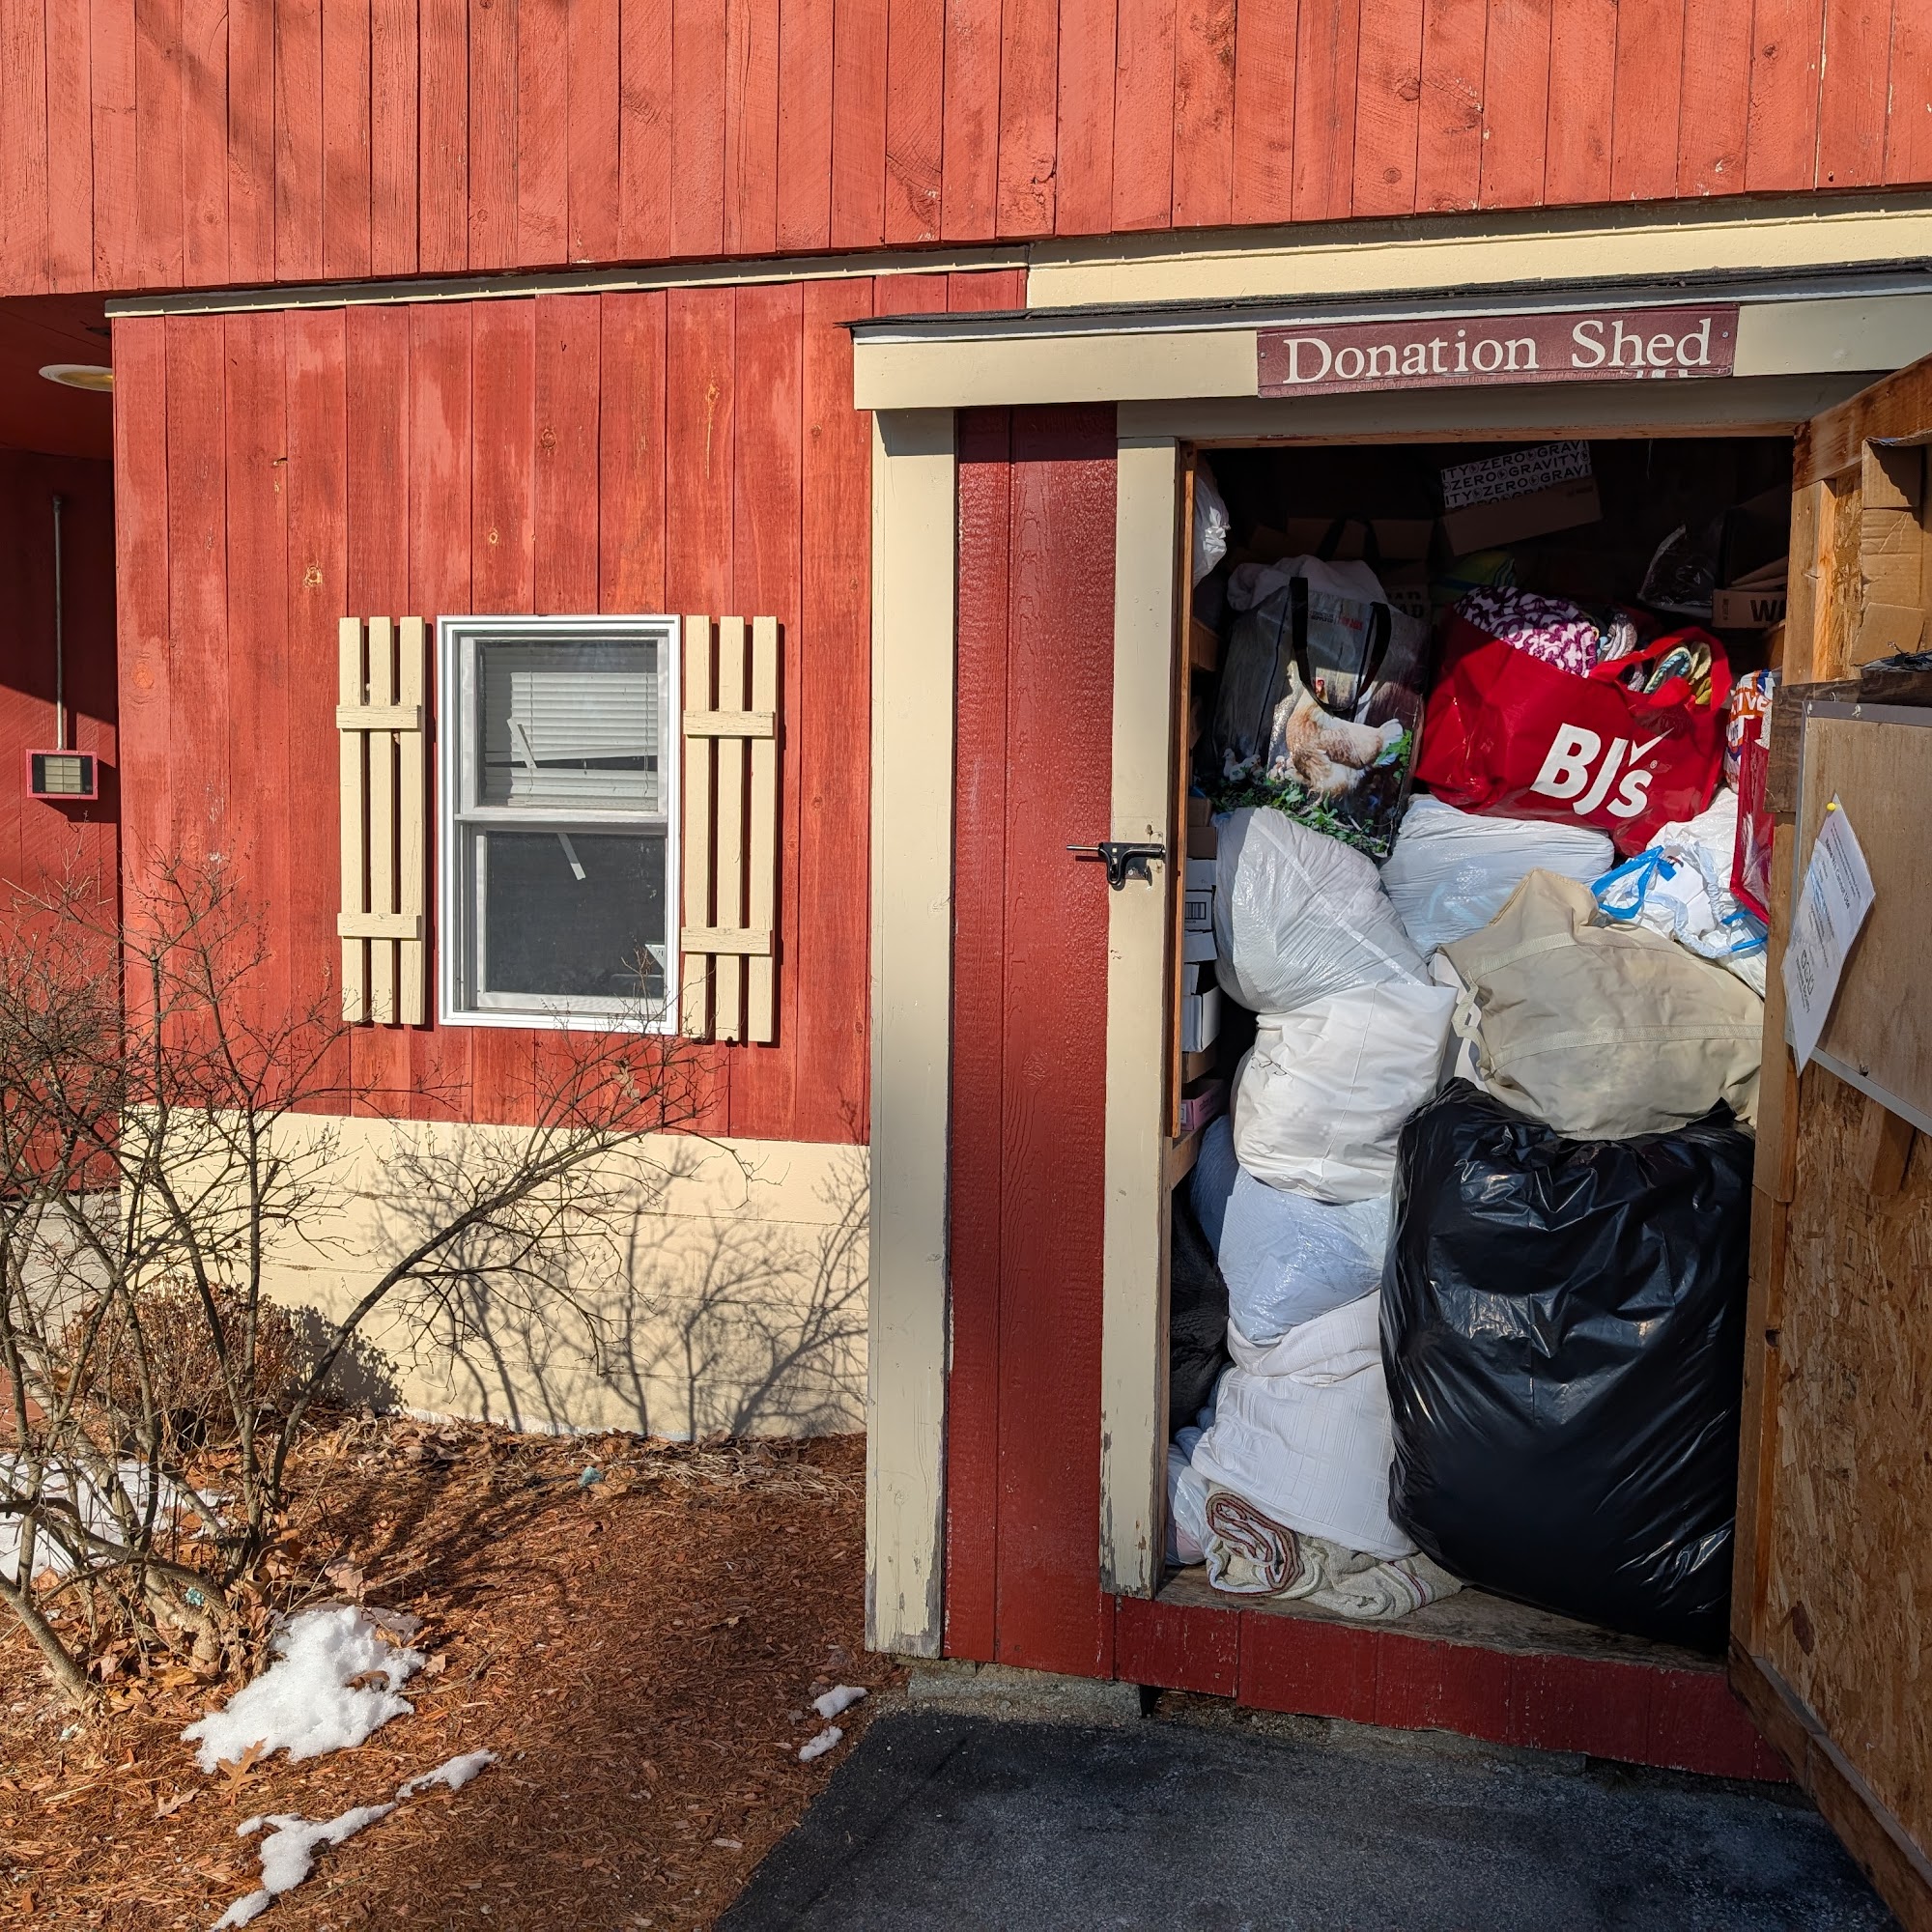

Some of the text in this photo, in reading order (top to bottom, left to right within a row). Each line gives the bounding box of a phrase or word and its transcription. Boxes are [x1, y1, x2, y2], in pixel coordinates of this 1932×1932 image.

[1282, 317, 1712, 384] Donation Shed
[1451, 451, 1579, 491] ZERO GRAVITY
[1480, 452, 1525, 472] ZERO
[1483, 477, 1528, 497] ZERO
